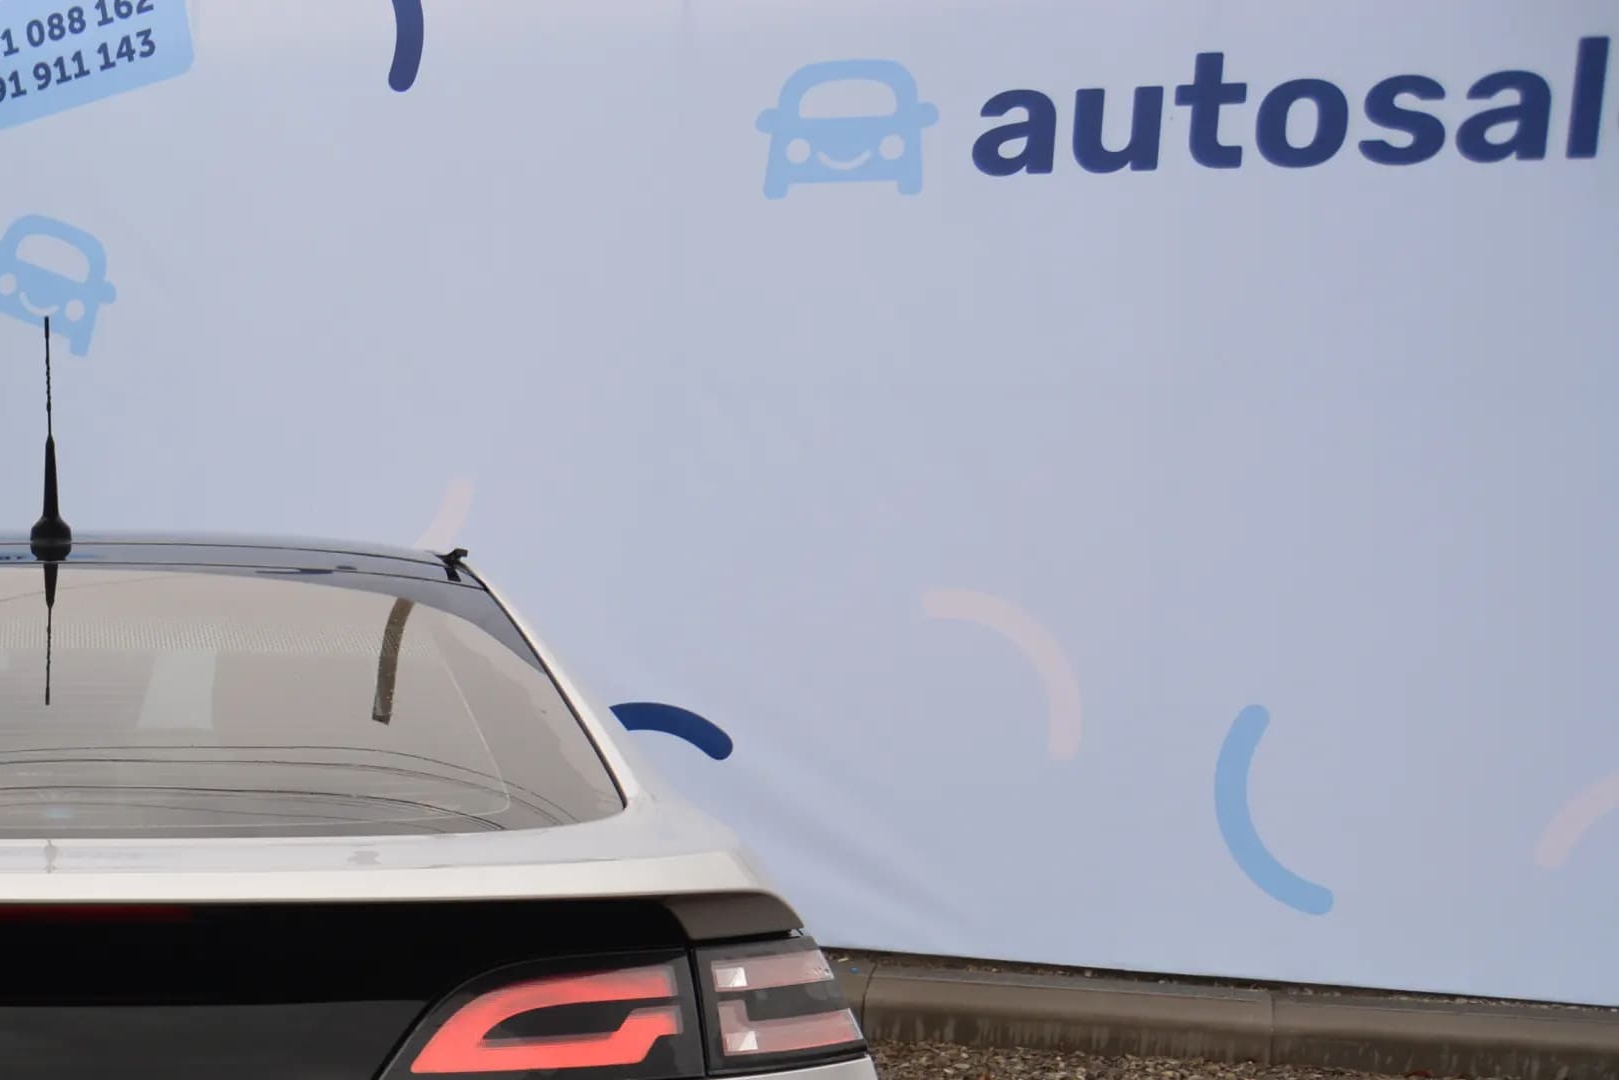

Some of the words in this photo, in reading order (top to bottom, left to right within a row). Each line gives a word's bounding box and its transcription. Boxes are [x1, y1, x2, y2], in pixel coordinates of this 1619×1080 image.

[26, 6, 87, 47] 088
[33, 50, 91, 90] 911
[97, 28, 157, 71] 143
[971, 36, 1619, 177] autosal
